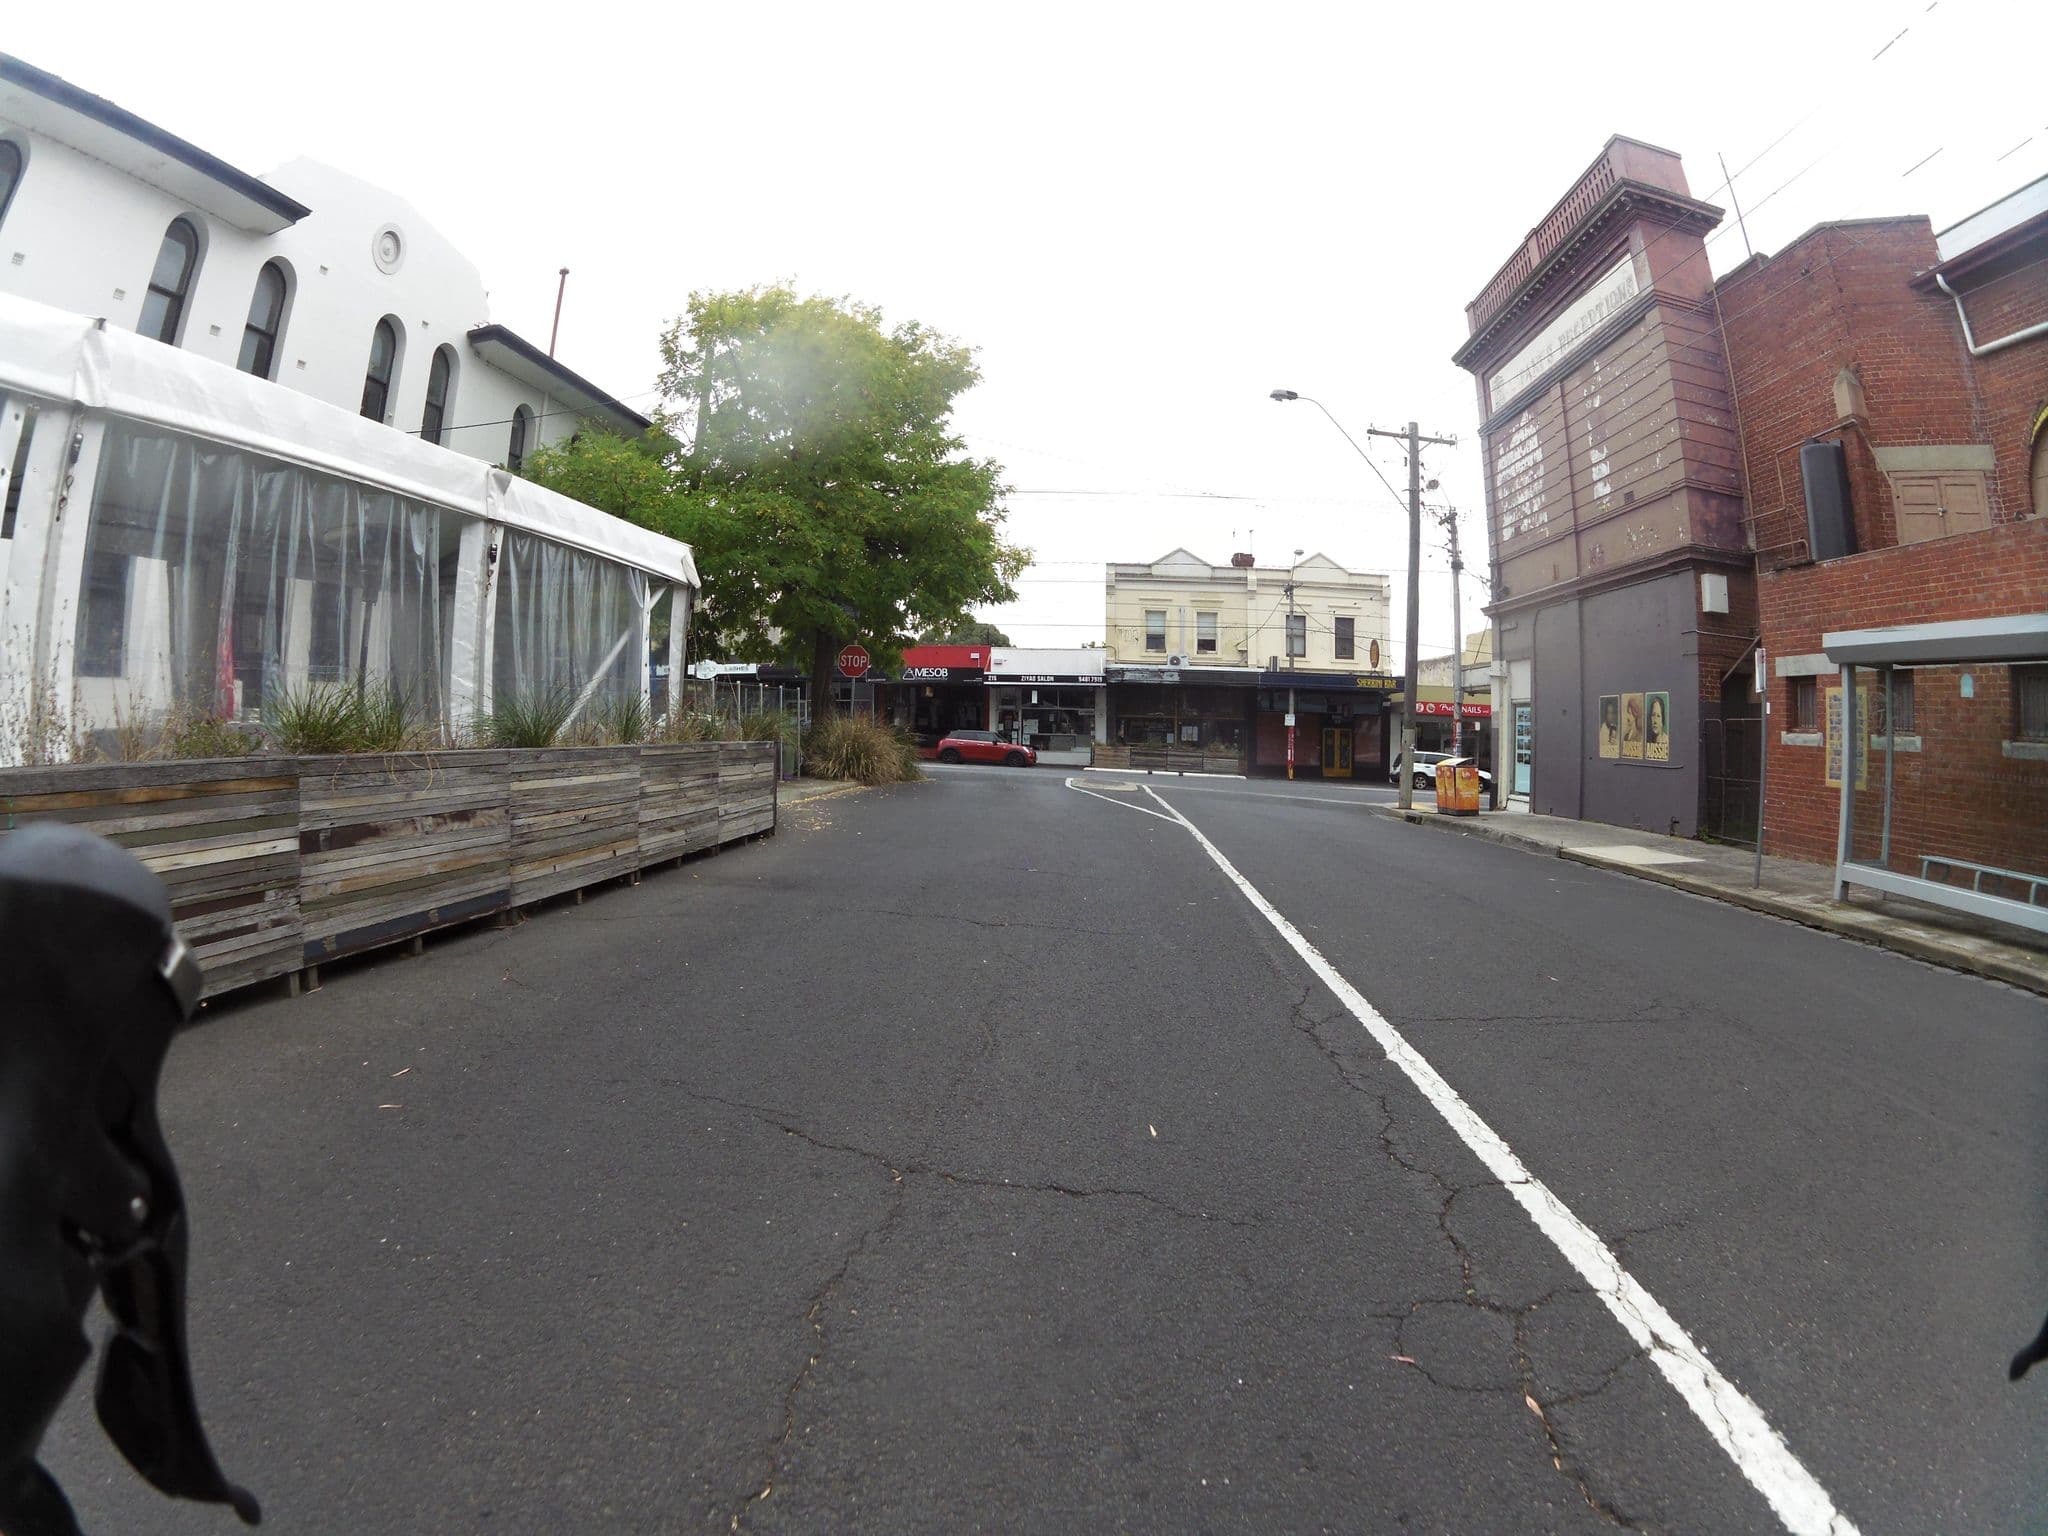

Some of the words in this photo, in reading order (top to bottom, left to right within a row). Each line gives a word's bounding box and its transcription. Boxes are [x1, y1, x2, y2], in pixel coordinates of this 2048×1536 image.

[840, 655, 867, 667] STOP
[914, 667, 948, 677] MESOB
[1461, 706, 1482, 714] NAILS
